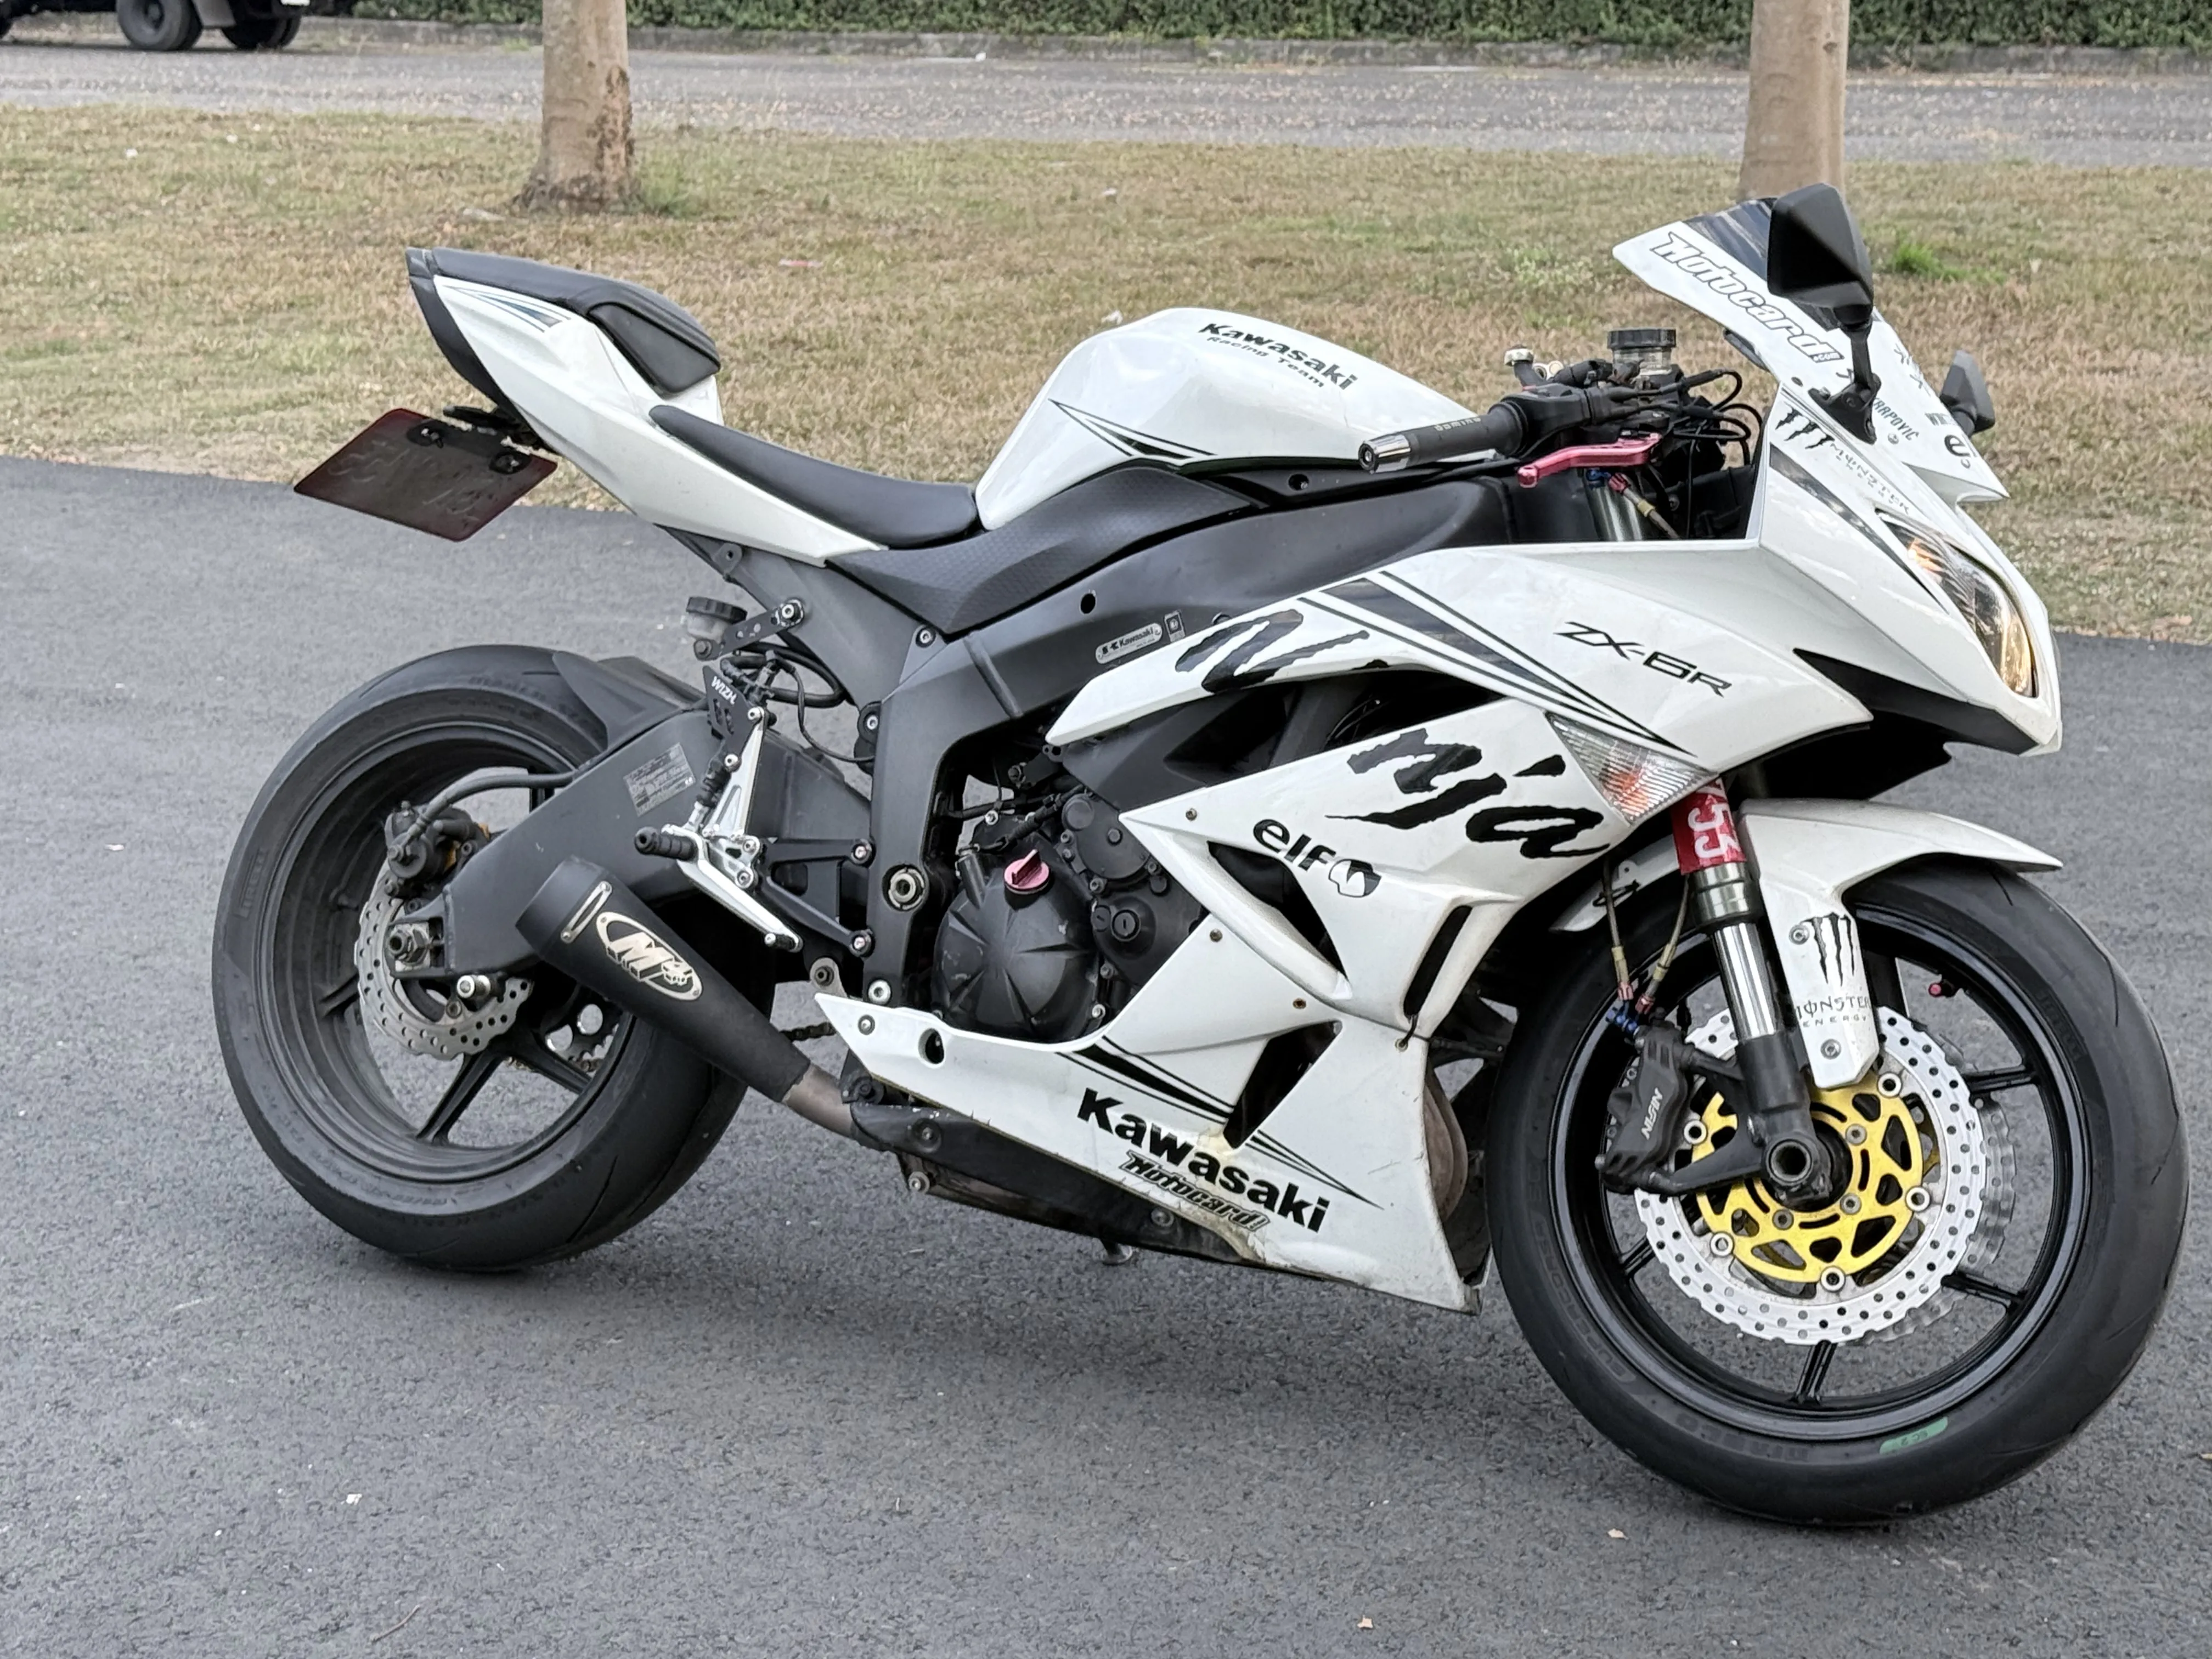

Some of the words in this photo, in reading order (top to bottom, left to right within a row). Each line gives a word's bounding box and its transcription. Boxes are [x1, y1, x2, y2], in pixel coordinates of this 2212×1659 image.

[1650, 232, 1839, 358] Motocard
[1198, 323, 1358, 390] Kawasaki
[1206, 337, 1269, 357] Racing
[1278, 357, 1324, 387] Team
[1555, 620, 1733, 698] ZX-6R
[1174, 609, 1611, 860] Nnja
[1252, 818, 1337, 872] elf
[1803, 1013, 1867, 1028] ENERGY
[1077, 1087, 1330, 1233] Kawasaki
[1119, 1149, 1269, 1231] Motocard
